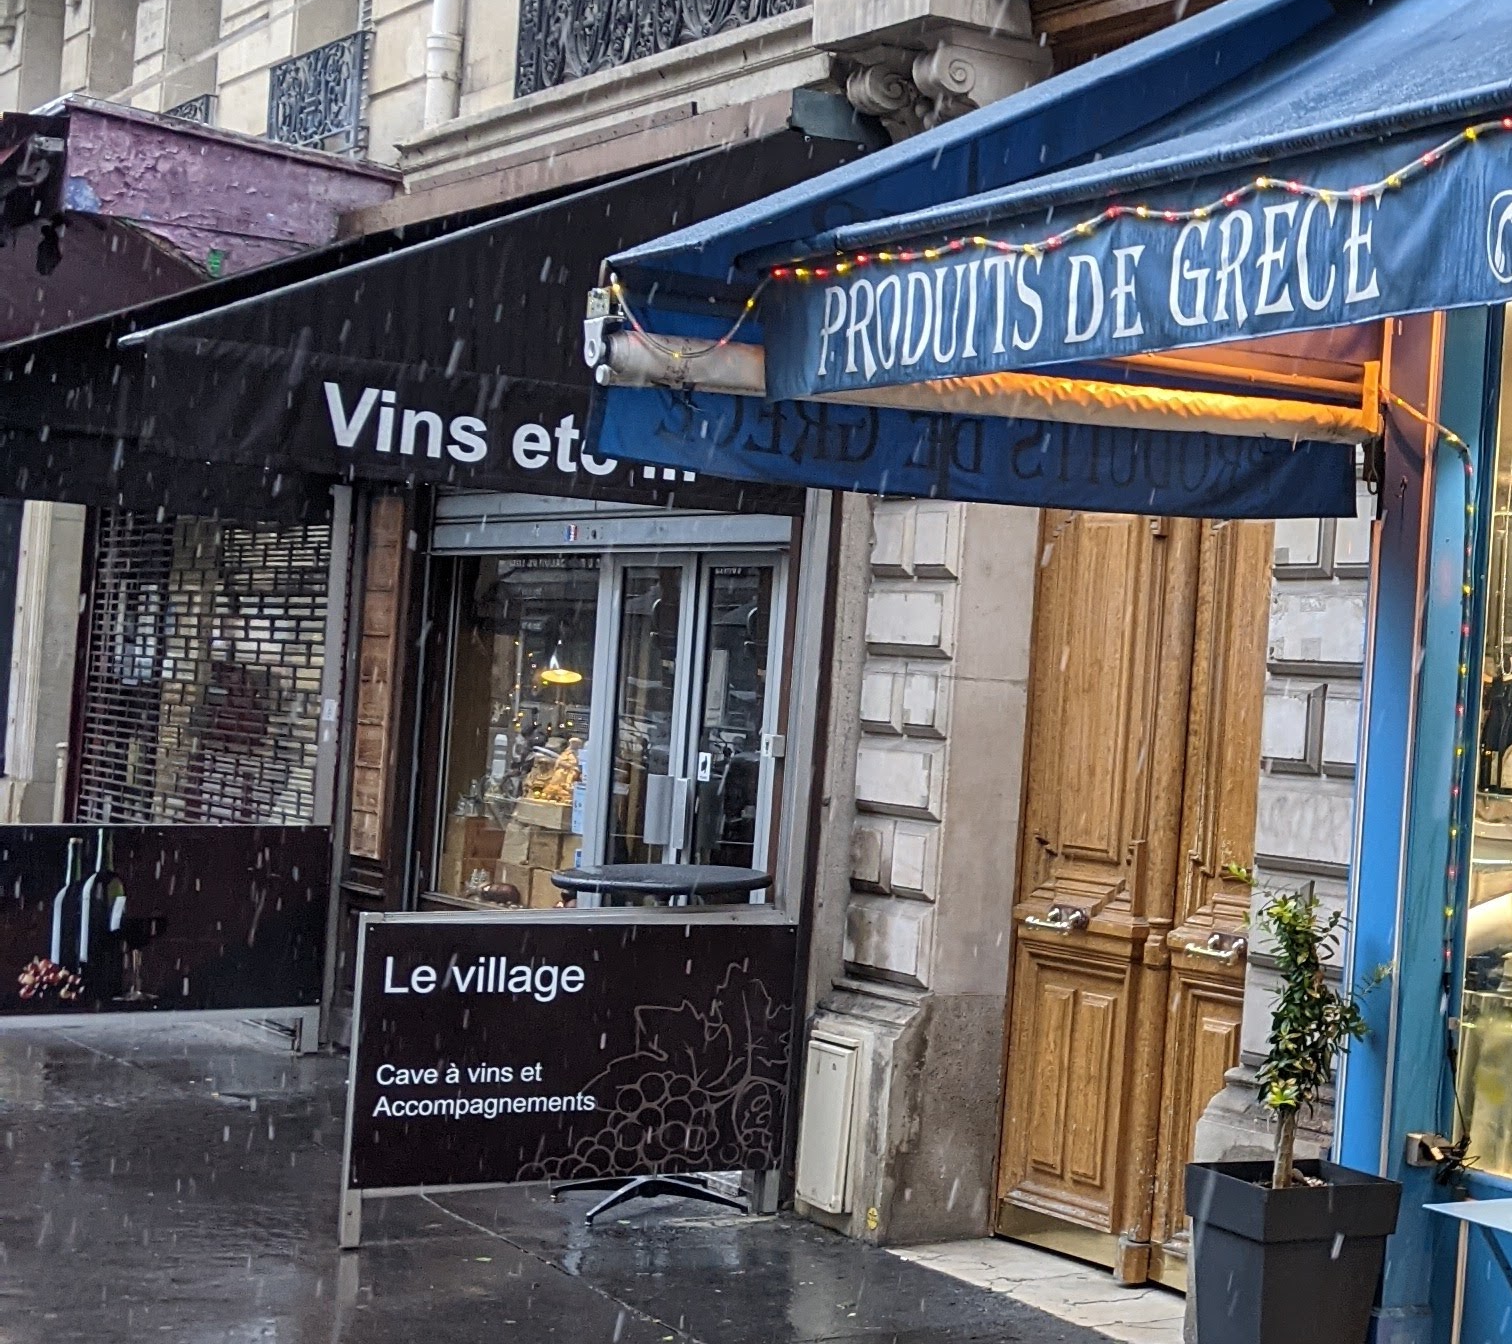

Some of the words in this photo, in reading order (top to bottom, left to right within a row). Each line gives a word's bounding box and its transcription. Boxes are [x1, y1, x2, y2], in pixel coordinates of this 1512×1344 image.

[817, 250, 1044, 383] PRODUITS
[1063, 244, 1146, 344] DE
[1168, 190, 1385, 329] GRECE
[323, 381, 488, 463] Vins
[384, 956, 438, 995] Le
[452, 955, 586, 1003] village
[376, 1063, 439, 1086] Cave
[445, 1062, 460, 1085] à
[467, 1062, 514, 1084] vins
[520, 1061, 544, 1083] et
[372, 1092, 597, 1120] Accompagnements
